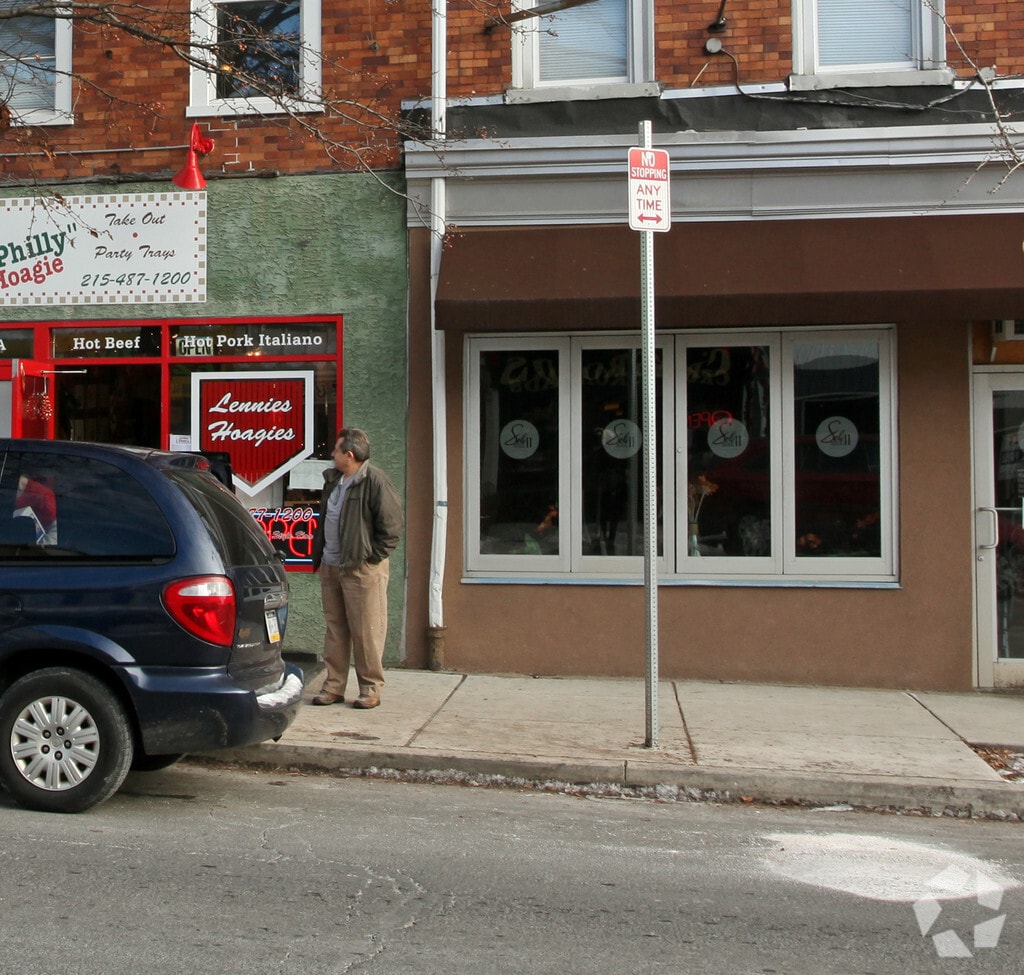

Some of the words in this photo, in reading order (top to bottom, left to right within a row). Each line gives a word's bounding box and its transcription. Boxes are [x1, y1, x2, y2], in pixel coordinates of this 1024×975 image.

[641, 151, 656, 167] NO
[631, 166, 667, 180] STOPPING
[636, 184, 661, 196] ANY
[636, 198, 662, 211] TIME
[105, 213, 136, 227] Take
[141, 212, 166, 225] Out
[94, 245, 133, 260] Party
[138, 244, 177, 258] Trays
[80, 271, 192, 288] 215-487-1200
[73, 337, 101, 350] Hot
[105, 336, 140, 349] Beef
[183, 335, 212, 348] Hot
[216, 334, 254, 347] Pork
[258, 333, 322, 347] Italiano
[208, 392, 292, 413] Lennies
[208, 420, 296, 447] Hoagies
